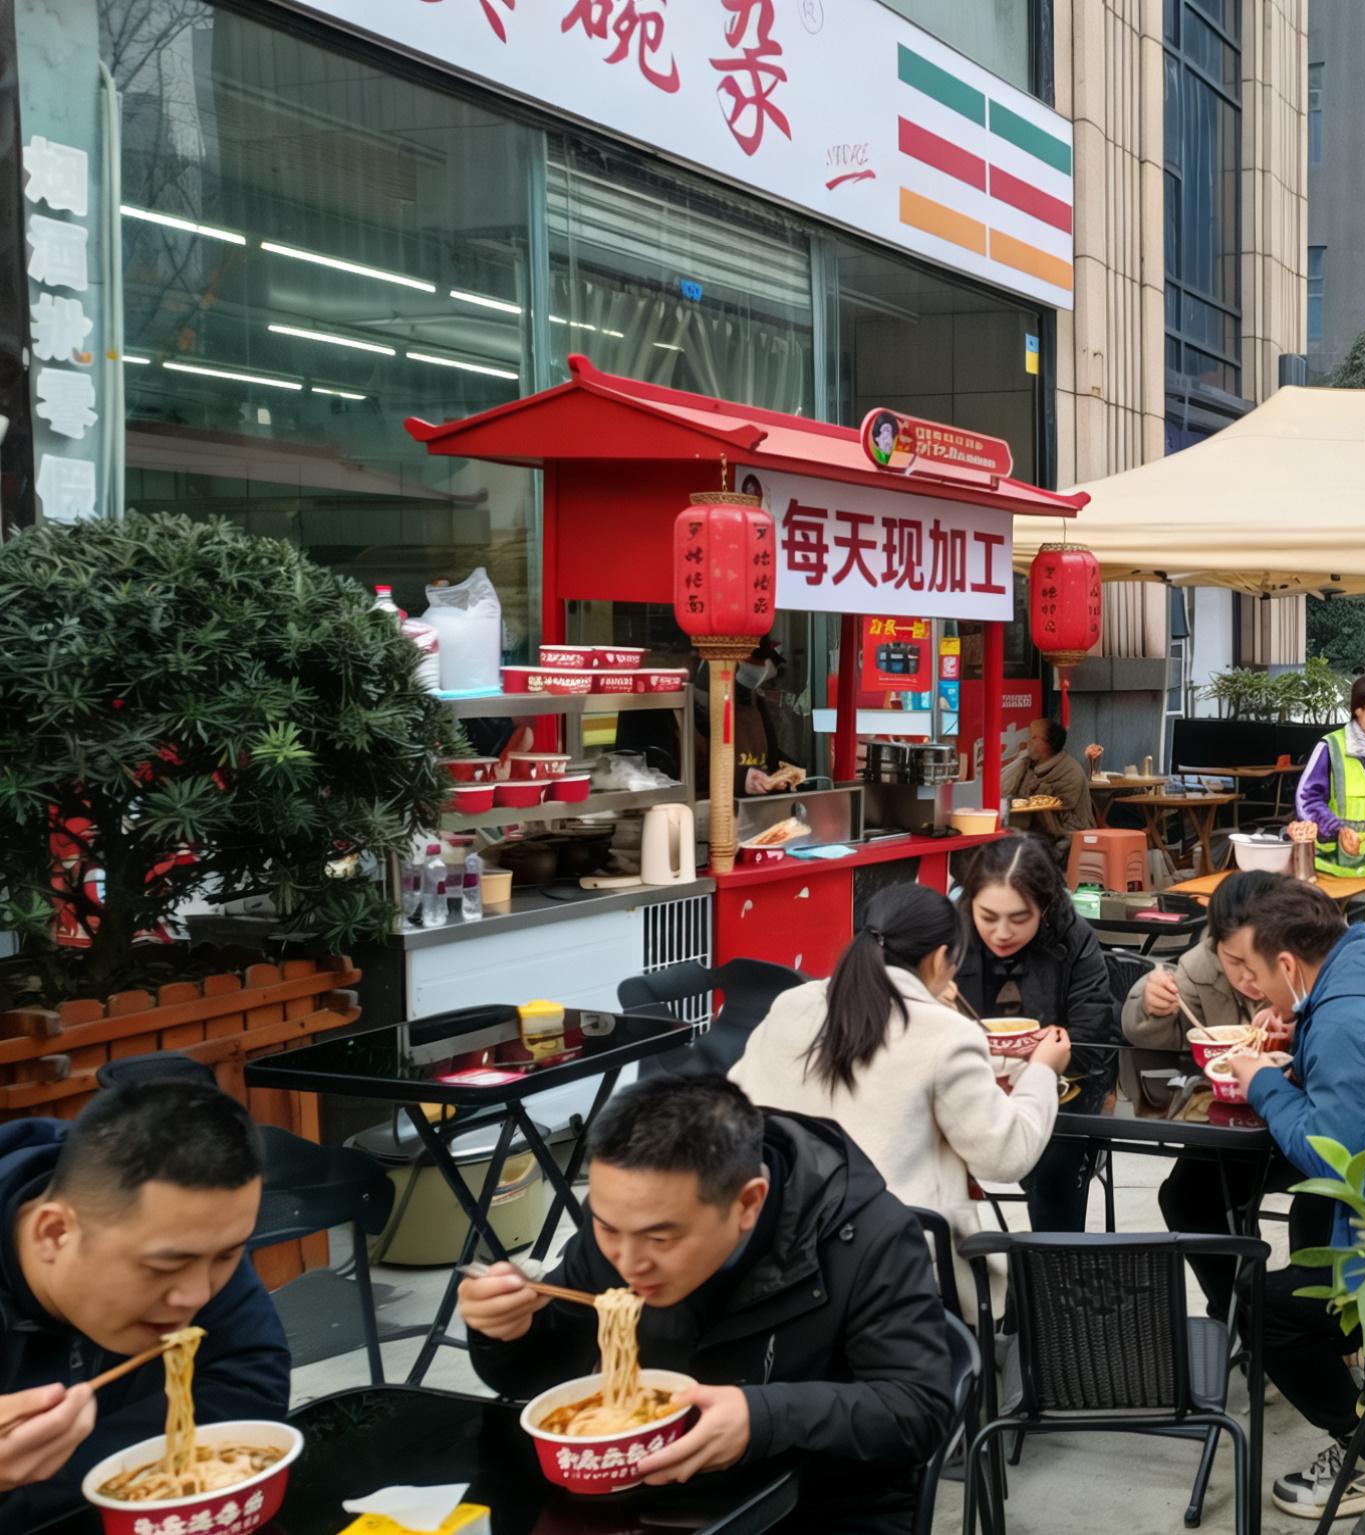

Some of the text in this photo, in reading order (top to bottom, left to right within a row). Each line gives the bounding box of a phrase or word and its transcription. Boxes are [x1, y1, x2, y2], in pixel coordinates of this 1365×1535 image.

[780, 497, 1007, 596] 每天现加工
